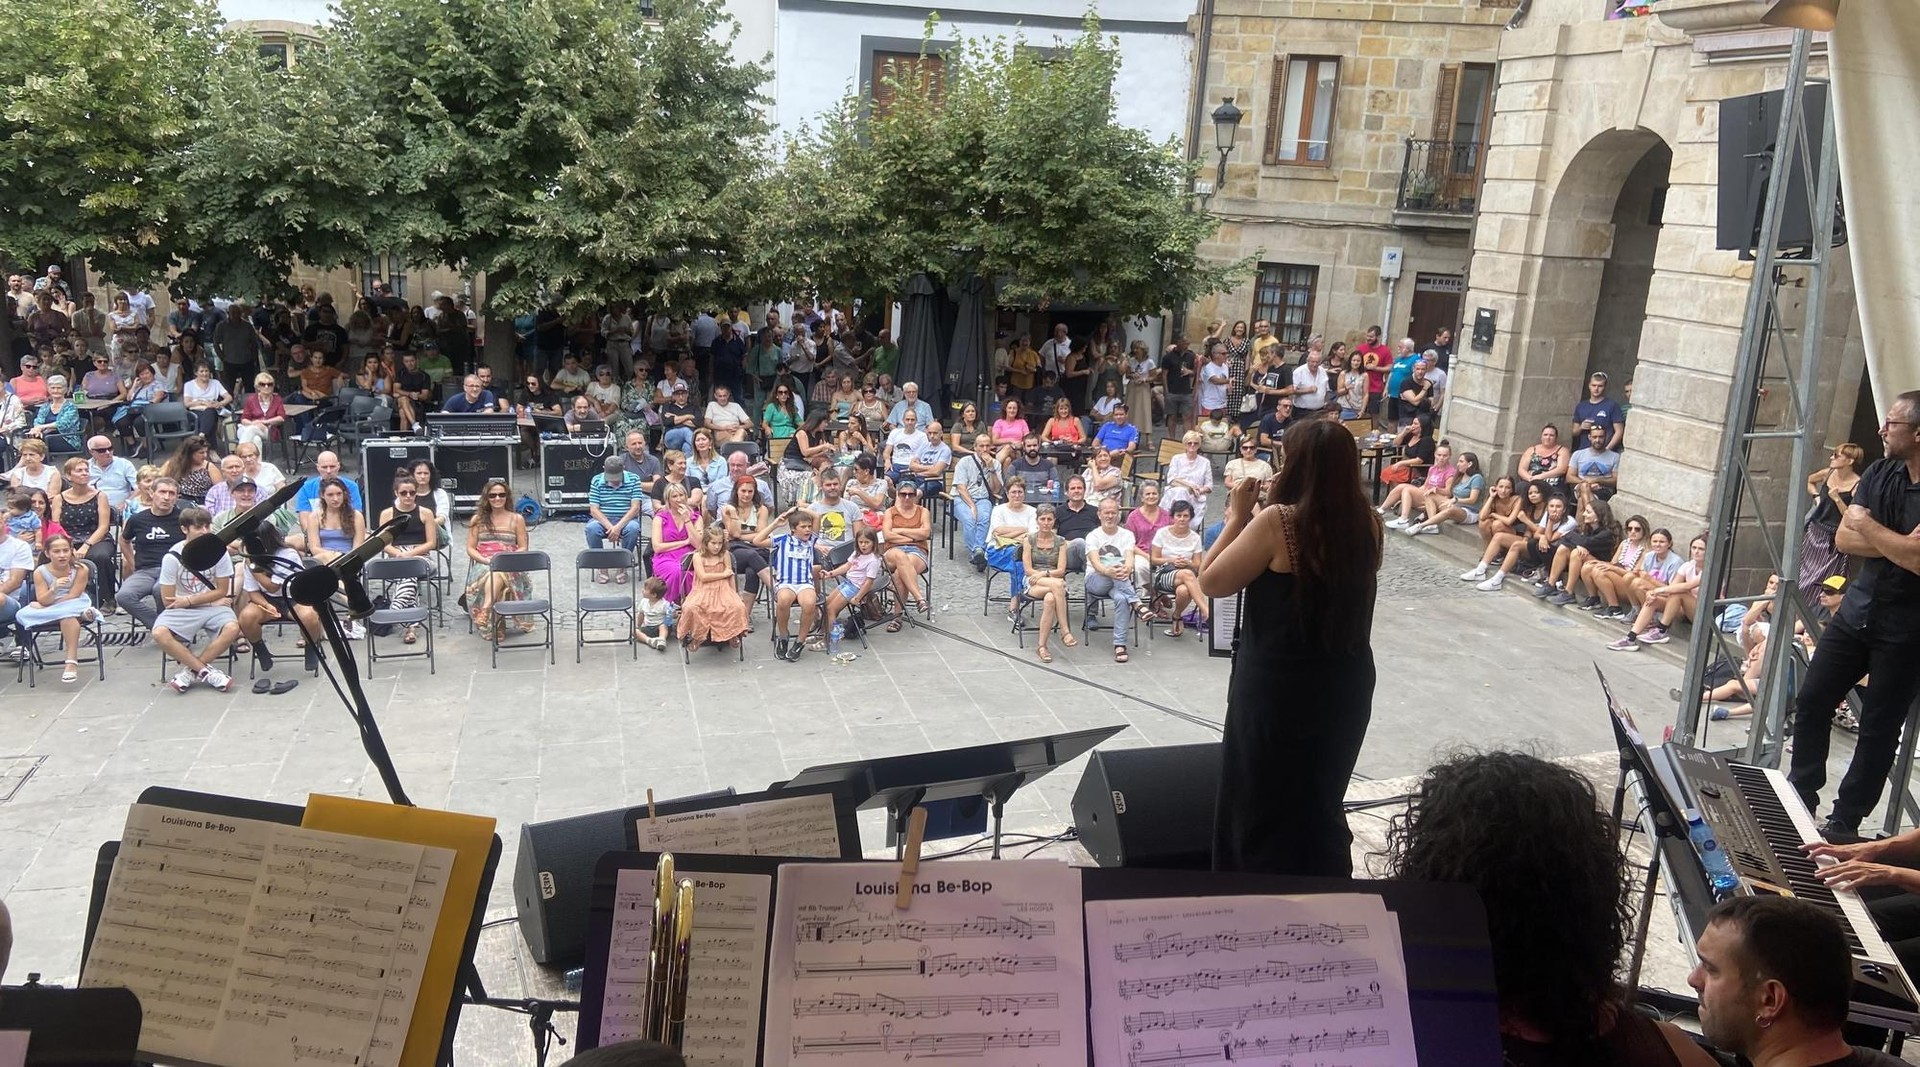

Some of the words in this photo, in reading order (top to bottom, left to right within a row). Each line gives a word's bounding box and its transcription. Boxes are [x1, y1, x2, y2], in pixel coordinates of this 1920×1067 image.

[161, 815, 203, 829] Louisiana
[205, 820, 236, 834] Be-Bop
[666, 814, 695, 824] Louisiana
[542, 873, 553, 896] NEXT
[695, 880, 726, 890] Be-Bop
[855, 881, 931, 895] Louisina
[937, 880, 993, 895] Be-Bop
